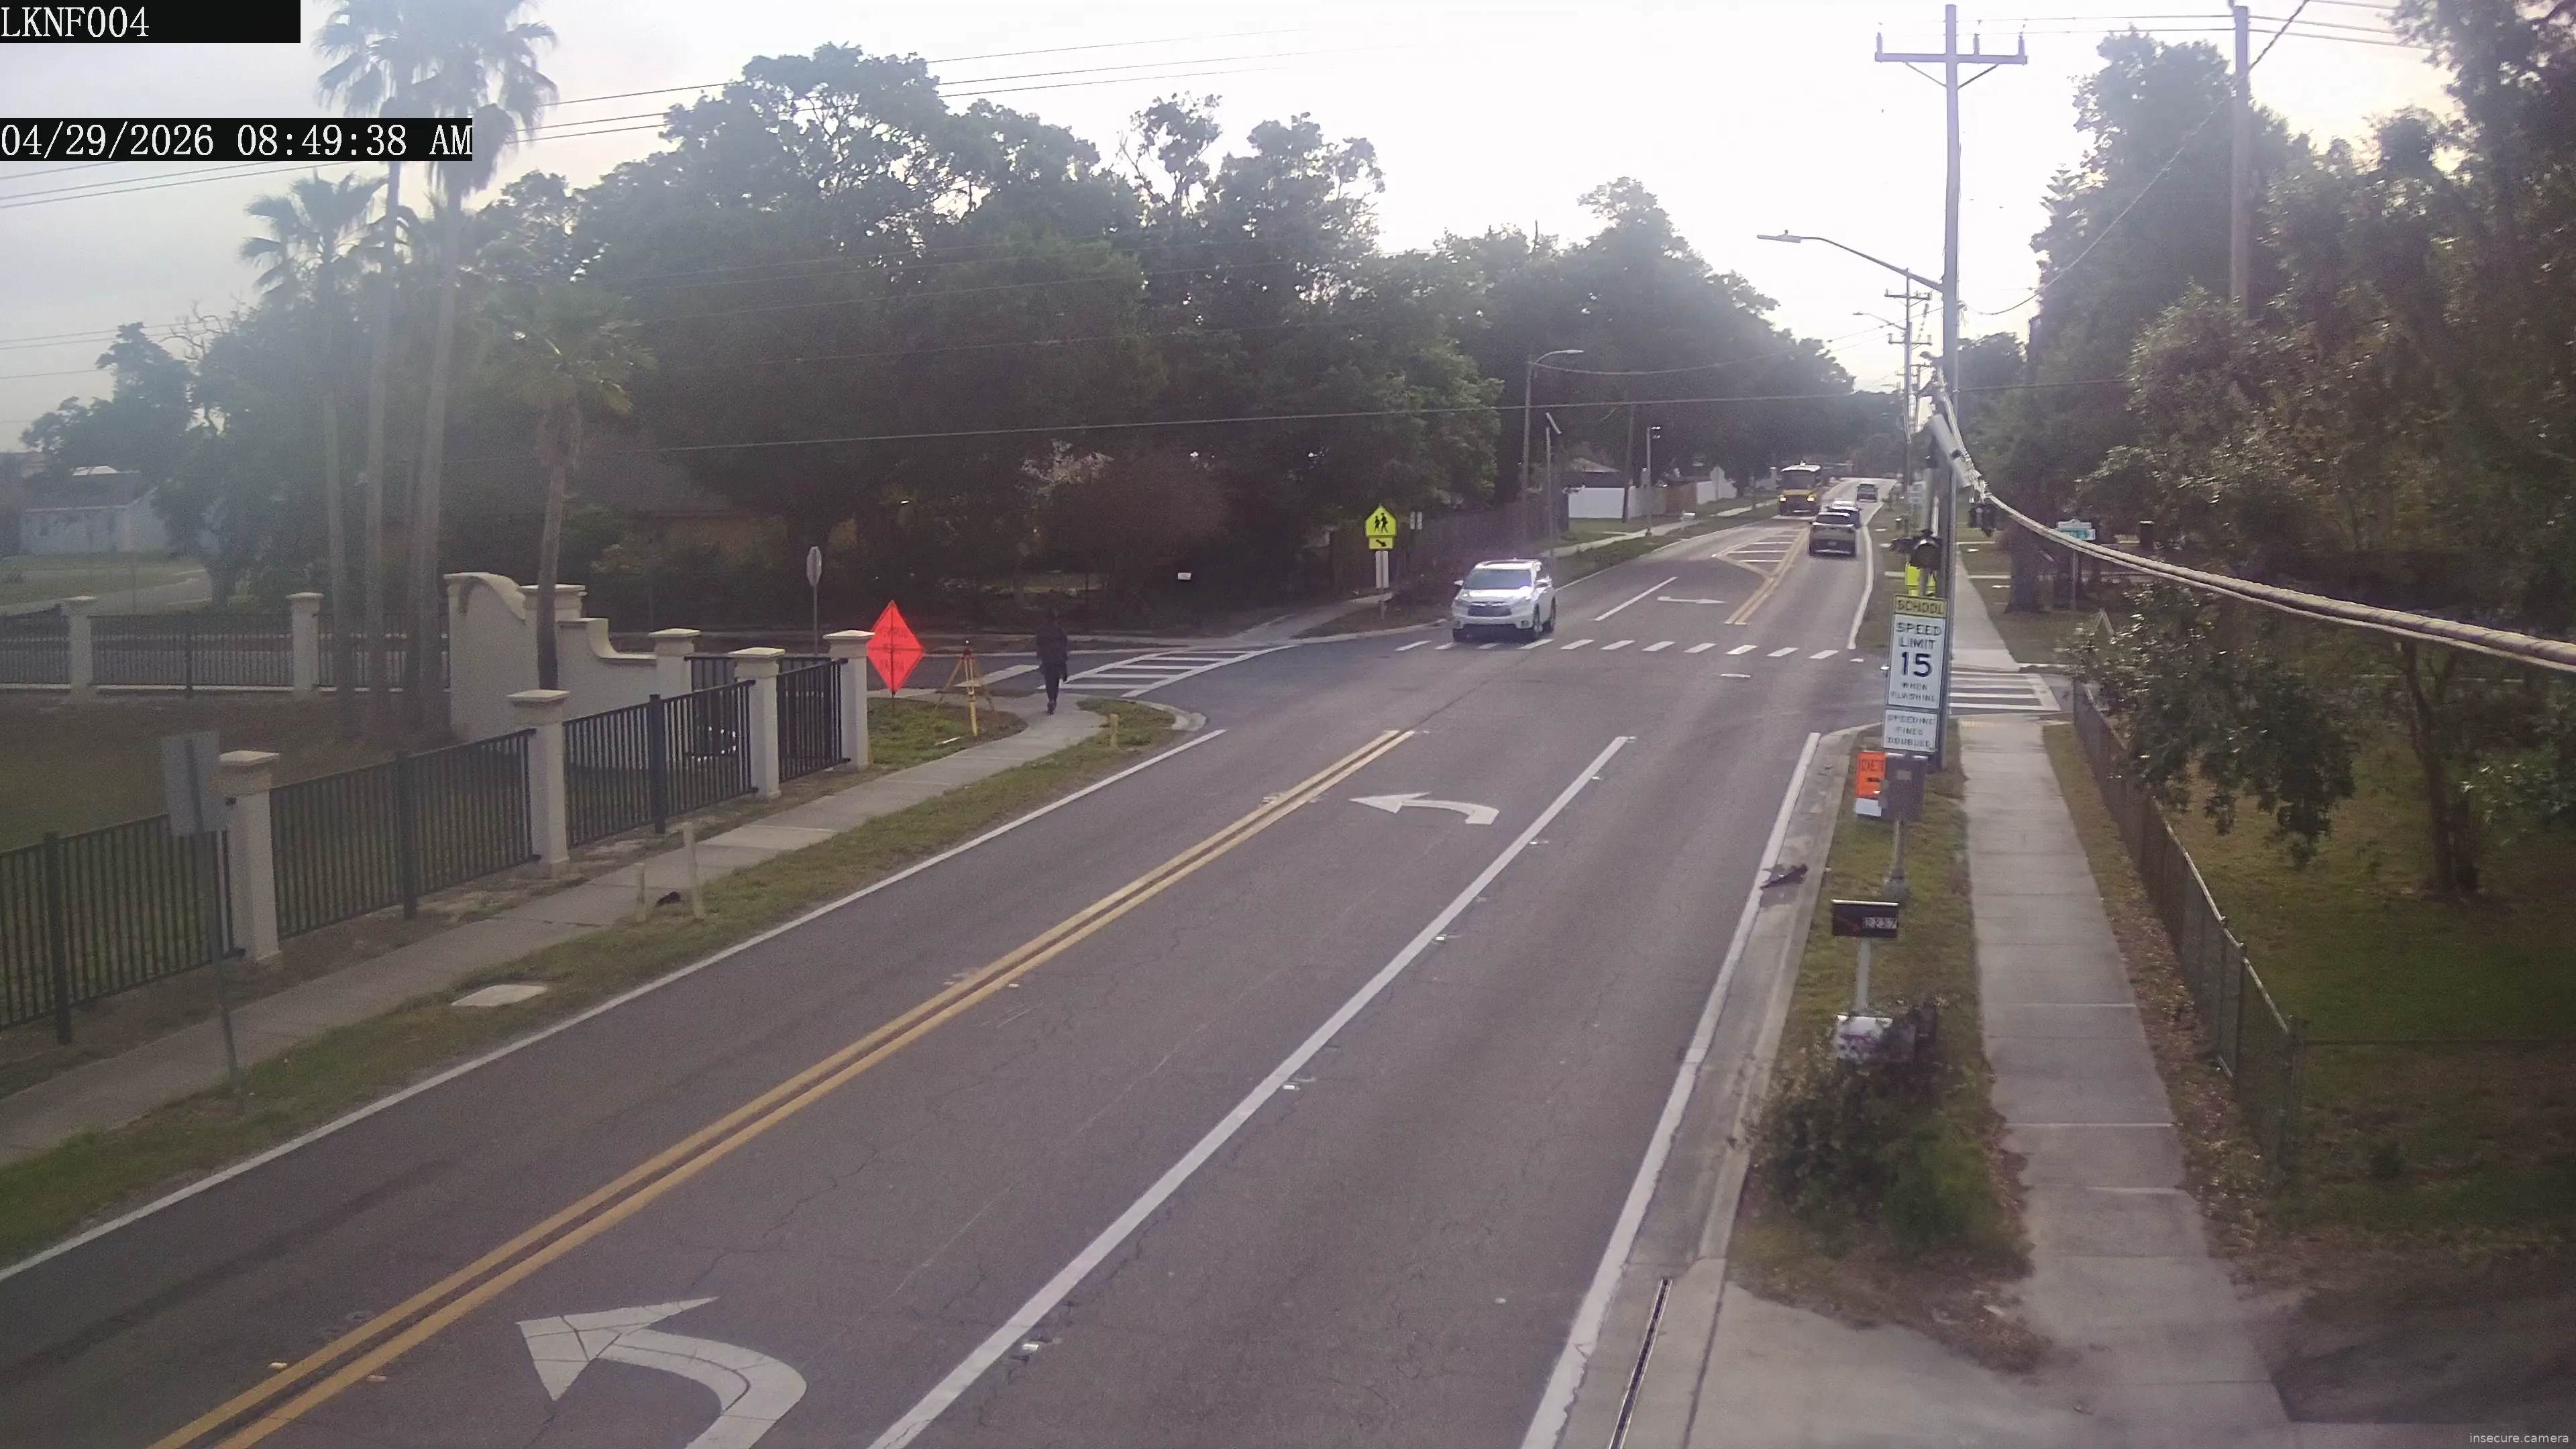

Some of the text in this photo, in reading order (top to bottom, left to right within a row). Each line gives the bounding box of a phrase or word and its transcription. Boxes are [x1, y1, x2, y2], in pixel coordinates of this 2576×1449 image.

[1897, 600, 1944, 614] SCHOOL
[1895, 622, 1941, 636] SPEED
[1898, 636, 1936, 649] LIMIT
[1902, 651, 1933, 677] 15
[1901, 682, 1928, 690] WHEN
[1896, 727, 1924, 736] FINES
[1887, 737, 1931, 747] DOUBLED
